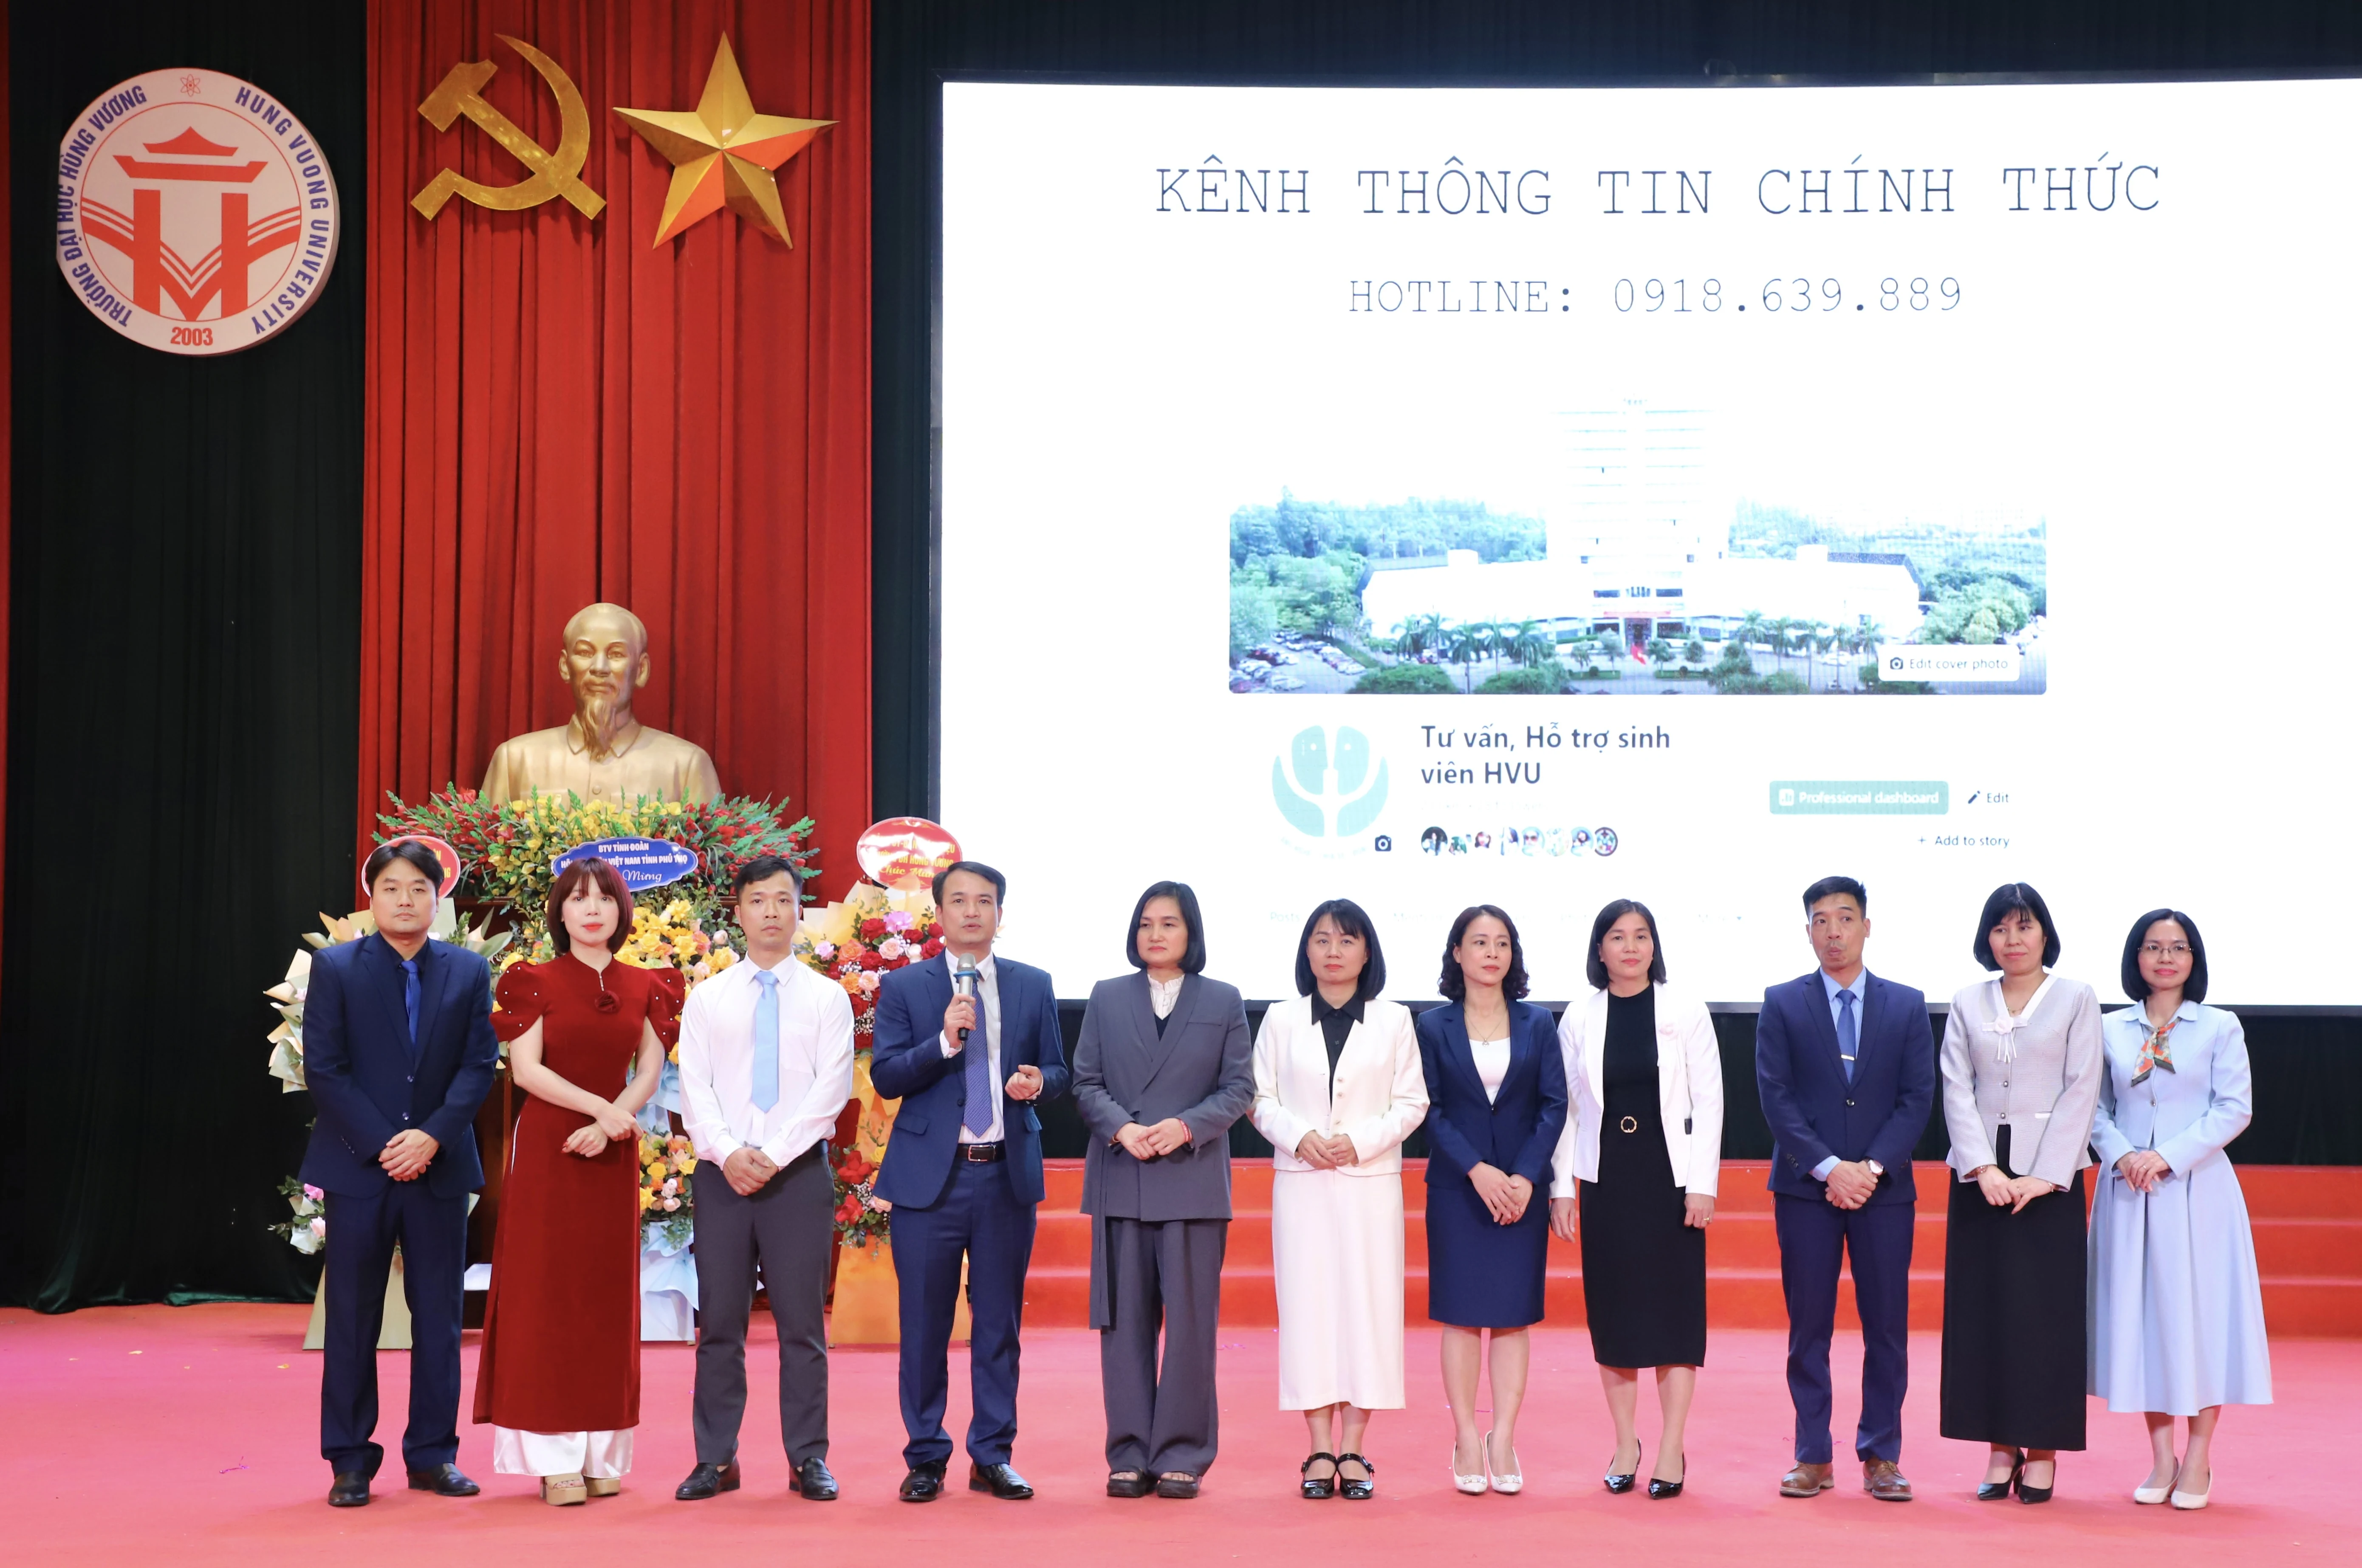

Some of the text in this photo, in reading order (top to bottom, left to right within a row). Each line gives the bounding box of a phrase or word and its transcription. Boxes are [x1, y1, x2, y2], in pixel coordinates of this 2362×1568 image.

[1156, 151, 2159, 215] KÊNH THÔNG TIN CHÍNH THỨC
[57, 85, 147, 327] TRƯỜNG ĐẠI HỌC HÙNG VƯƠNG
[235, 86, 329, 334] HUNG VUONG UNIVERSITY
[1349, 277, 1960, 312] HOTLINE: 0918.639.889
[170, 327, 213, 346] 2003
[1910, 659, 2008, 671] Edit cover photo
[1421, 722, 1670, 753] Tư vấn, Hỗ trợ sinh
[1421, 761, 1540, 784] viên HVU
[1799, 791, 1939, 804] Professional dashboard
[1987, 793, 2009, 803] Edit
[598, 840, 649, 853] BTV TỈNH ĐOÀN
[1935, 835, 2010, 849] Add to story
[608, 856, 623, 868] VIỆT
[624, 857, 641, 865] NAM
[641, 854, 658, 864] TỈNH
[658, 853, 673, 863] PHÚ
[673, 854, 688, 864] THỌ
[622, 869, 662, 883] Mừng
